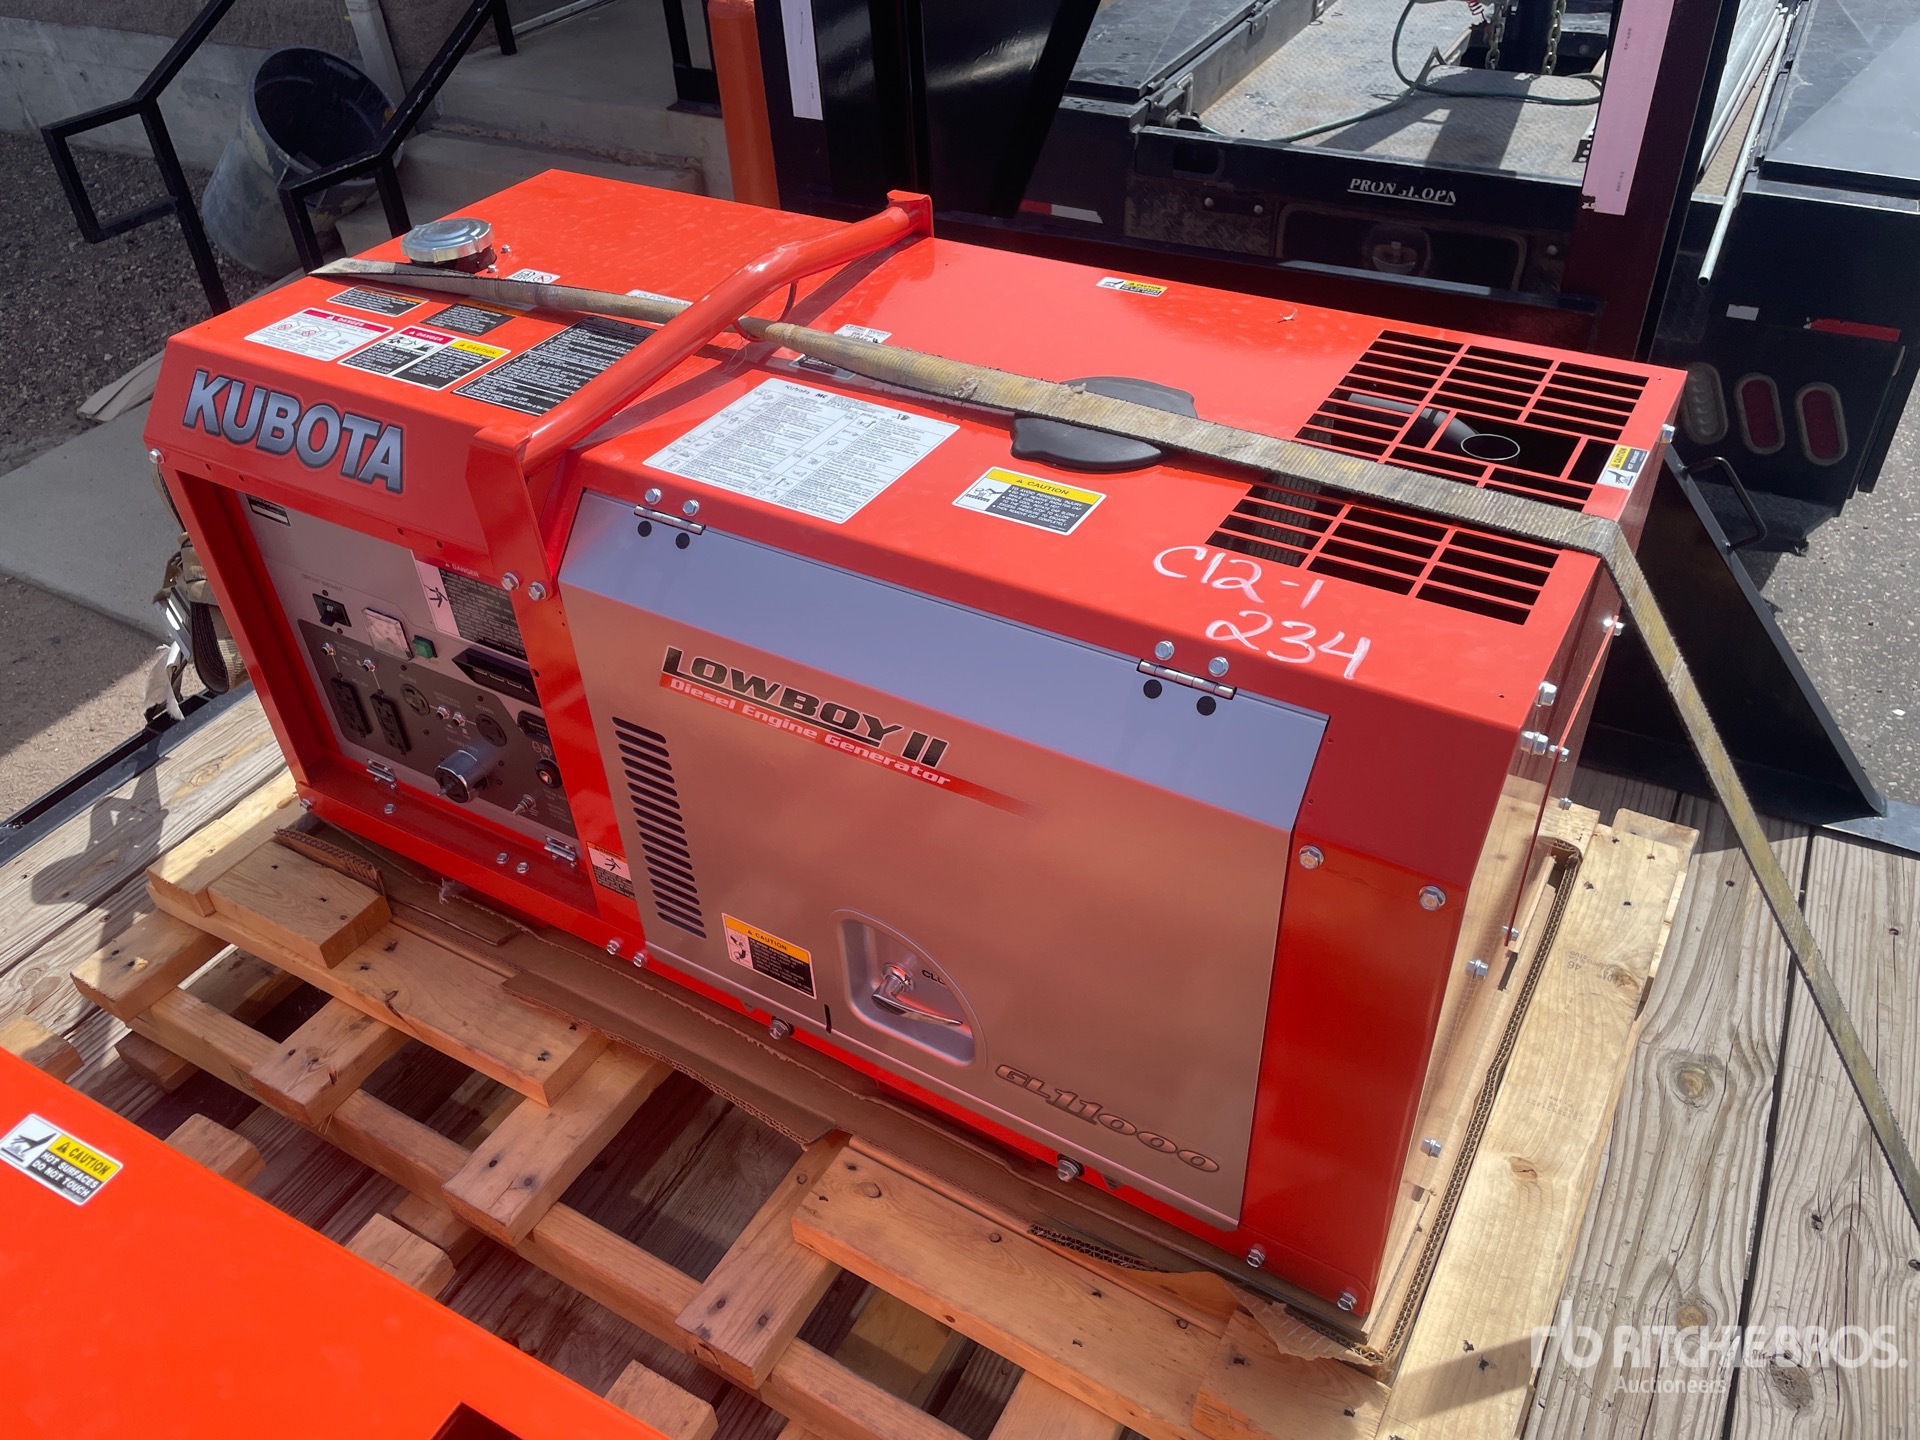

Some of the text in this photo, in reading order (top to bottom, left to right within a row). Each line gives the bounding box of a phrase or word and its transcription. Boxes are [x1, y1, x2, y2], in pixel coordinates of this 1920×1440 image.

[414, 332, 446, 342] DANGER
[182, 369, 404, 494] KUBOTA
[1026, 481, 1070, 495] CAUTION
[452, 564, 480, 578] DANGER
[1152, 545, 1325, 609] C12-1
[1205, 610, 1372, 680] 234
[661, 645, 949, 769] LOWBOY II
[670, 678, 951, 786] Diesel Engine Generator
[755, 932, 787, 951] CAUTION
[995, 1064, 1220, 1172] GL11000
[32, 1160, 91, 1198] DO NOT TOUCH
[41, 1152, 100, 1188] HOT SURFACES
[68, 1147, 111, 1176] CAUTION
